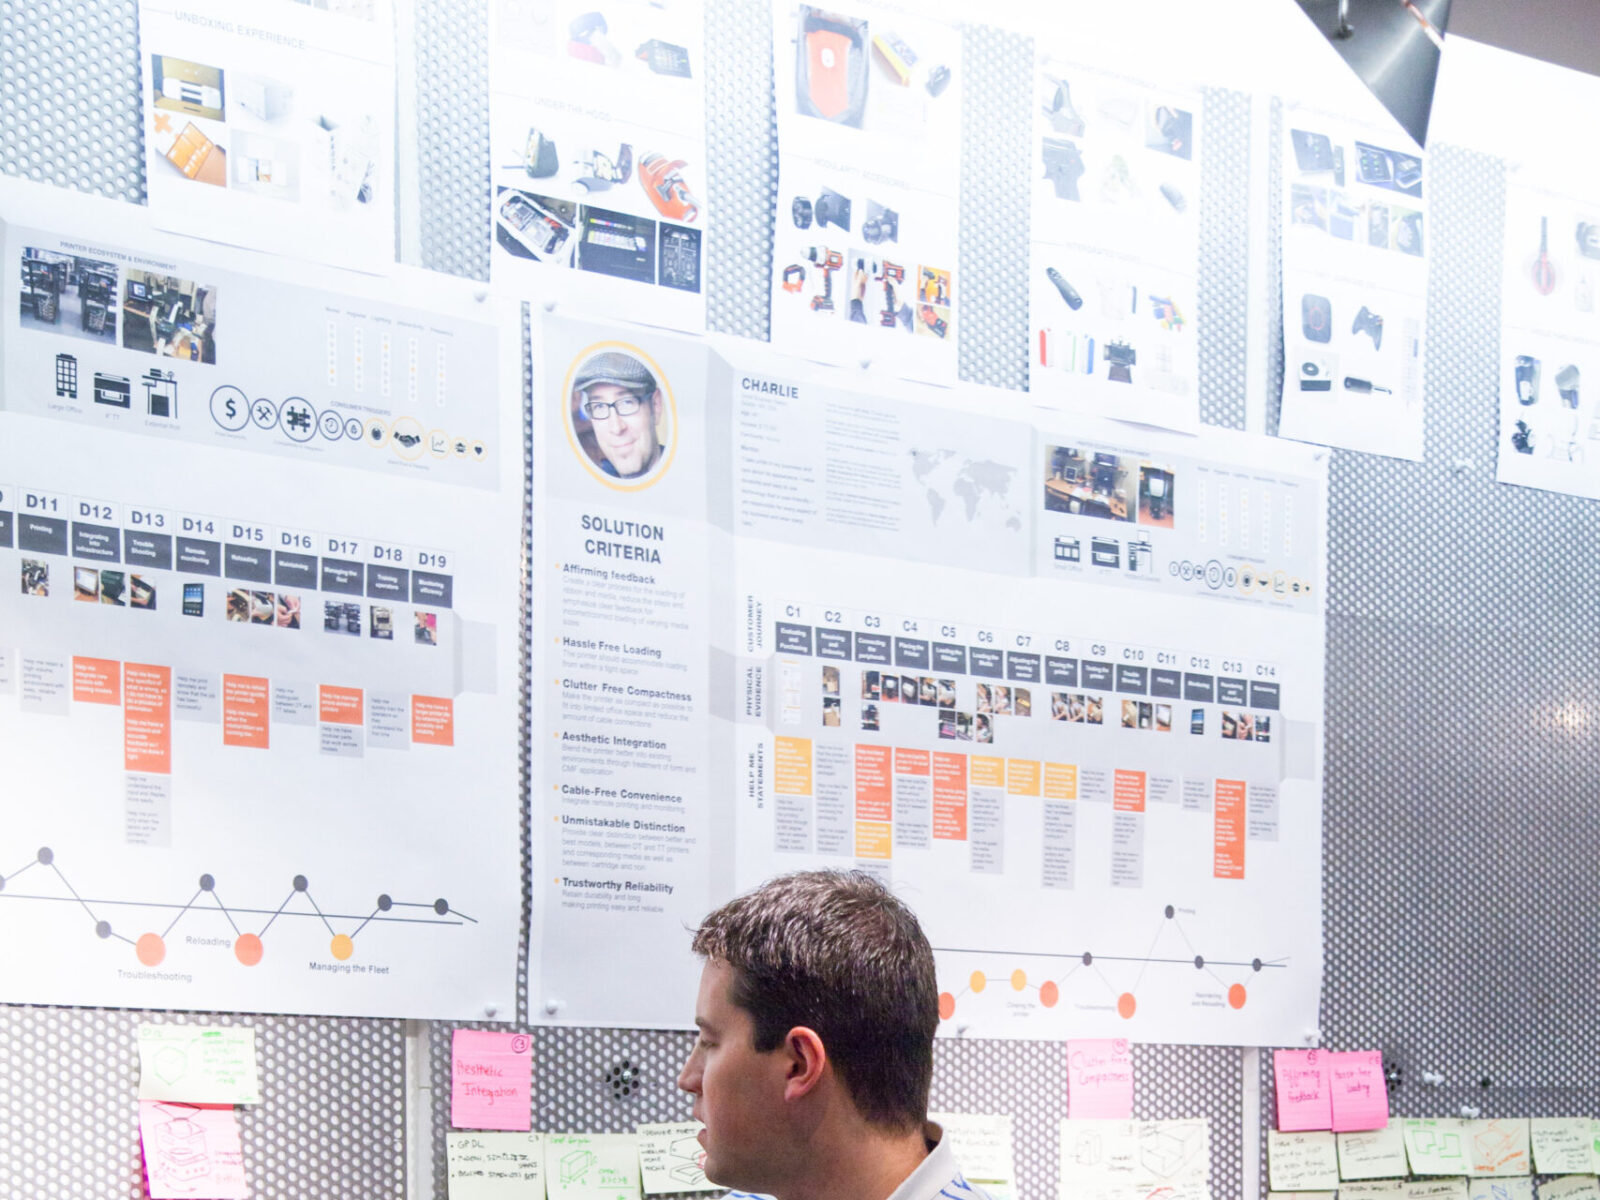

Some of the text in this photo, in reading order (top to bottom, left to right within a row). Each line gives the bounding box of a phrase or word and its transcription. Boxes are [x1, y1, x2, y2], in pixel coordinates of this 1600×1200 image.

[174, 10, 306, 50] UNBOXING EXPERIENCE
[533, 95, 566, 110] UNDER
[60, 241, 87, 251] PRINTER
[89, 246, 127, 260] ECOSYSTEM
[133, 256, 177, 270] ENVIRONMENT
[742, 377, 799, 399] CHARLIE
[26, 493, 58, 511] D11
[79, 502, 112, 520] D12
[131, 510, 165, 527] D13
[29, 523, 53, 534] Printing
[183, 517, 214, 534] D14
[232, 524, 264, 541] D15
[581, 515, 664, 541] SOLUTION
[281, 532, 312, 548] D16
[328, 539, 358, 554] D17
[373, 546, 402, 561] D18
[585, 539, 661, 564] CRITERIA
[418, 552, 447, 568] D19
[563, 563, 656, 584] Affirming feedback
[786, 605, 800, 618] C1
[824, 610, 842, 623] C2
[755, 601, 763, 648] JOURNEY
[864, 615, 881, 628] C3
[903, 620, 918, 632] C4
[941, 626, 956, 638] C5
[977, 631, 993, 643] C6
[563, 637, 662, 659] Hassle Free Loading
[1016, 635, 1031, 647] C7
[1055, 640, 1070, 651] C8
[1091, 644, 1106, 656] C9
[1123, 648, 1144, 661] C10
[1157, 653, 1176, 664] C11
[1190, 657, 1210, 669] C12
[1222, 661, 1242, 673] C13
[1256, 665, 1275, 676] C14
[562, 678, 692, 702] Clutter Free Compactness
[562, 731, 667, 749] Aesthetic Integration
[749, 752, 756, 768] ME
[562, 784, 682, 803] Cable-Free Convenience
[562, 815, 685, 833] Unmistakable Distinction
[562, 877, 674, 894] Trustworthy Reliability
[186, 936, 231, 948] Reloading
[118, 969, 193, 983] Troubleshooting
[309, 962, 390, 975] Managing the Fleet
[456, 1060, 504, 1078] Aesthetic
